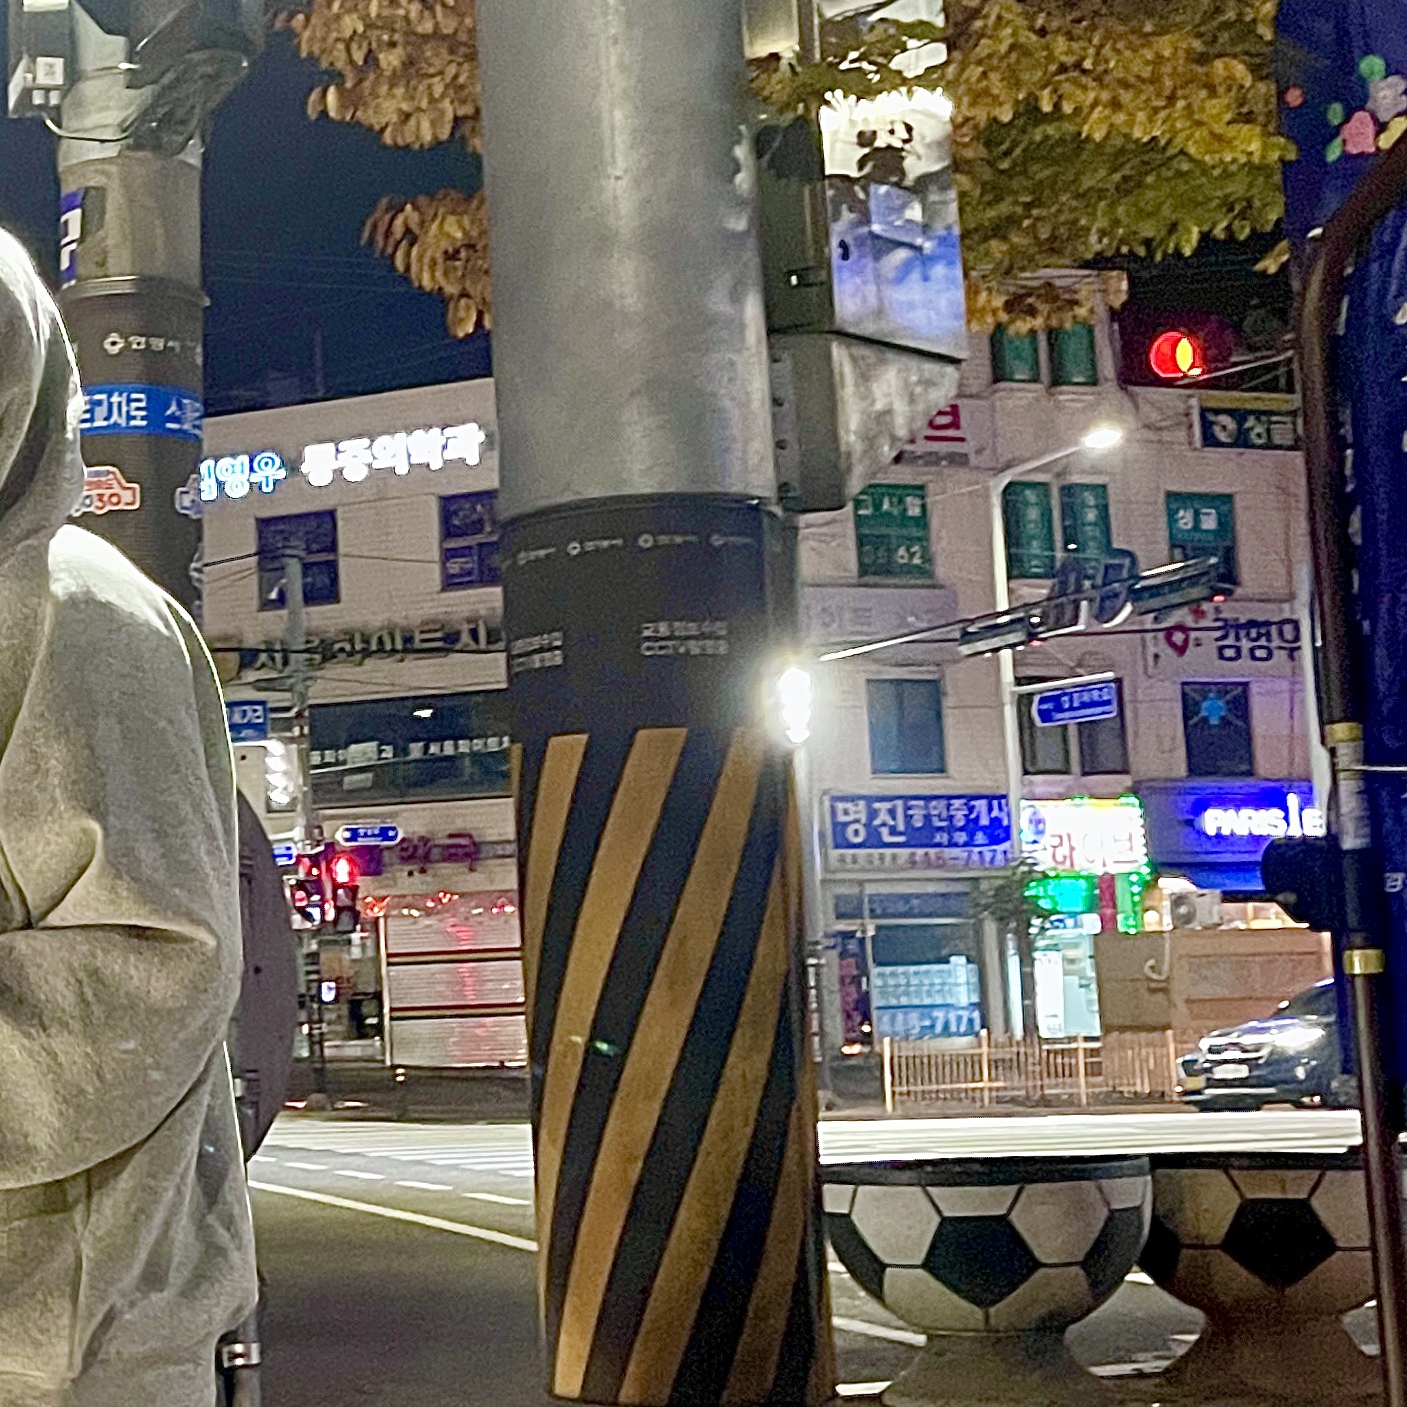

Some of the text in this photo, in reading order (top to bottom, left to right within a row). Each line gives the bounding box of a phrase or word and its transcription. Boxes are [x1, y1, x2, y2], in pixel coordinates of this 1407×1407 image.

[836, 799, 1009, 844] 명진 공인중개사
[1203, 807, 1288, 837] PARIS
[1049, 831, 1139, 869] 라이브
